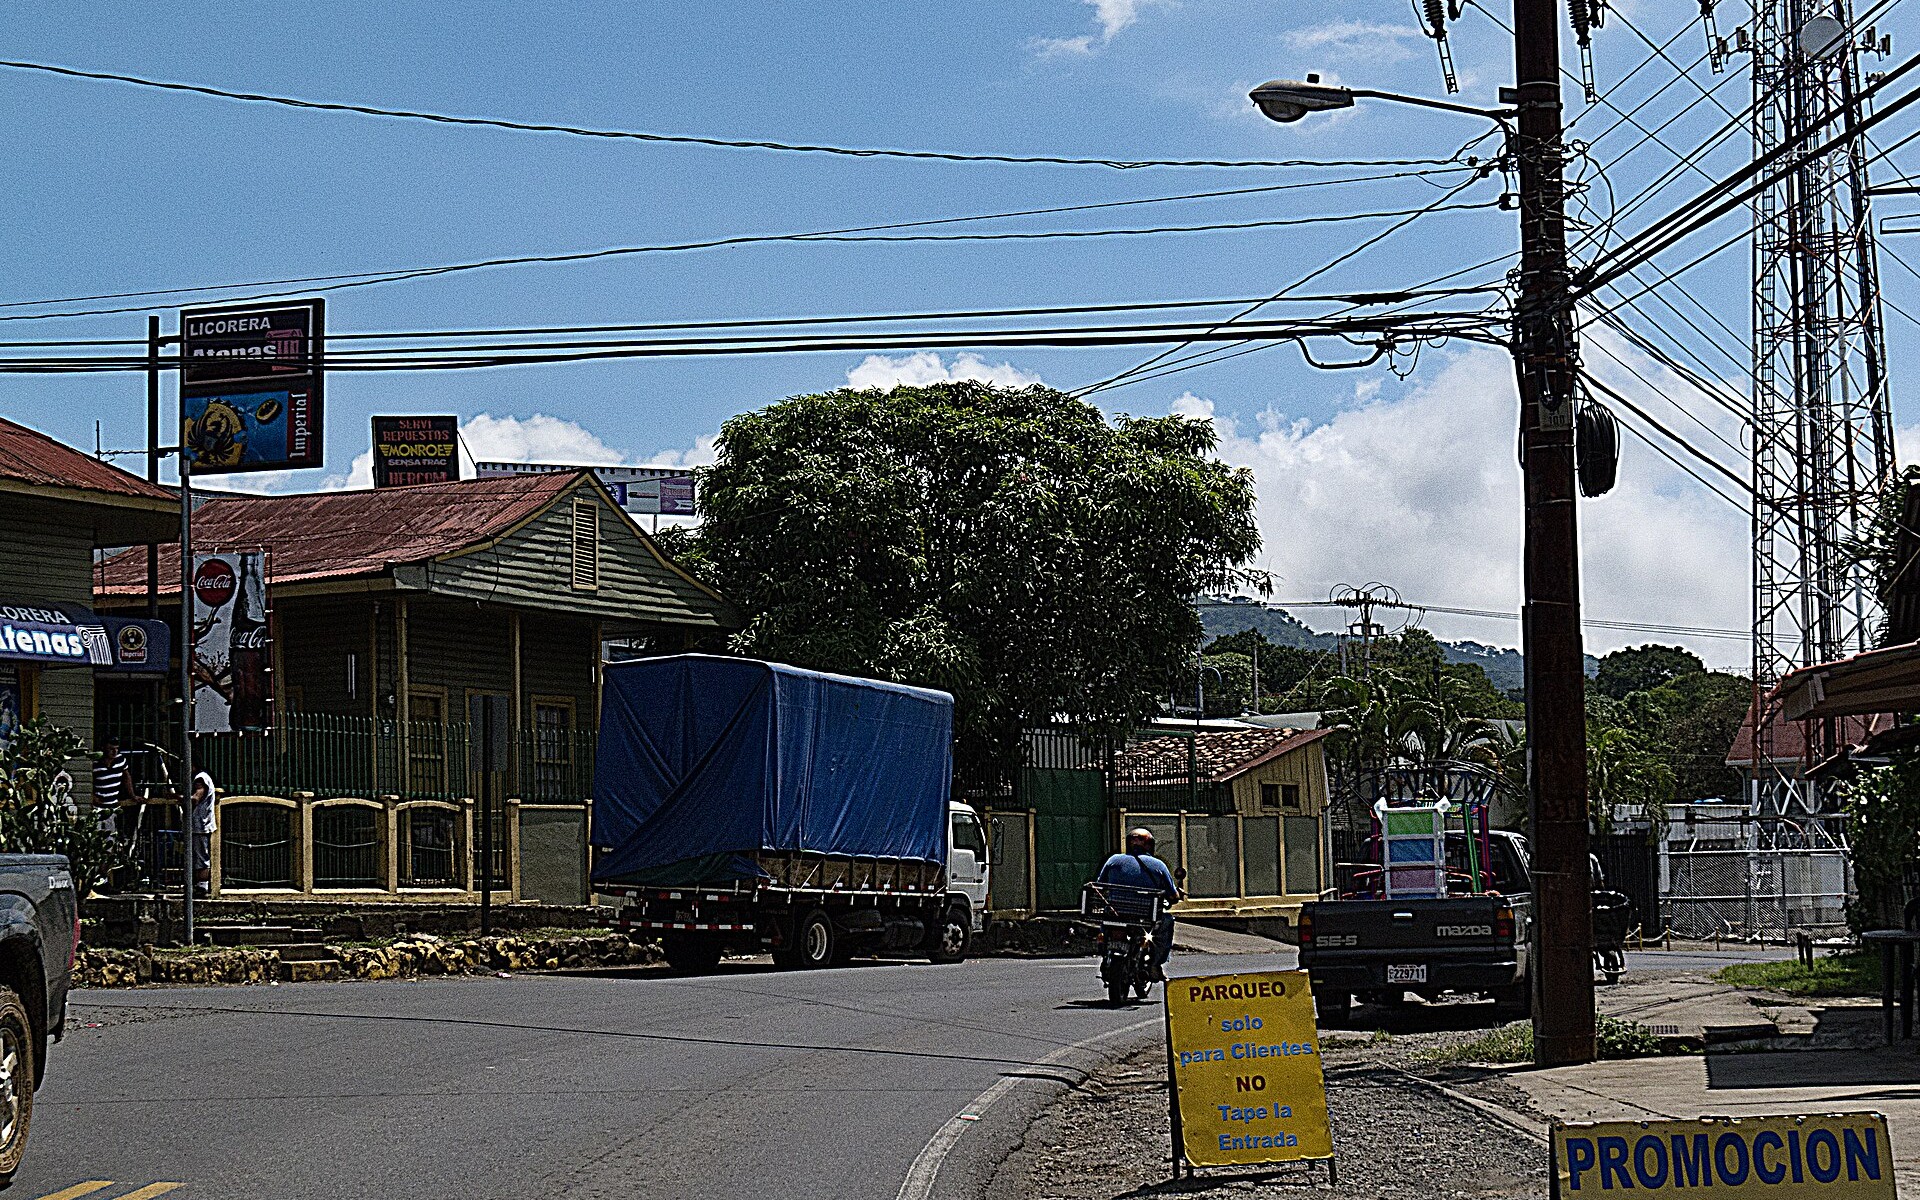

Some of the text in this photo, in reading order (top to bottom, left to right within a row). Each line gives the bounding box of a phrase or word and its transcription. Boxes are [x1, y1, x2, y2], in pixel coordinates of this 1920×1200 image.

[189, 316, 271, 337] LICORERA
[290, 392, 312, 459] Imperial
[399, 419, 432, 430] SERVI
[389, 443, 445, 457] MONROE
[0, 605, 71, 624] ORERA
[1394, 968, 1425, 979] 229711
[1189, 981, 1286, 1002] PARQUEO
[1221, 1014, 1264, 1032] solo
[1180, 1040, 1315, 1067] para Clientes
[1236, 1075, 1266, 1093] NO
[1218, 1102, 1292, 1124] Tape la
[1218, 1131, 1298, 1150] Entrada
[1565, 1127, 1882, 1191] PROMOCION
